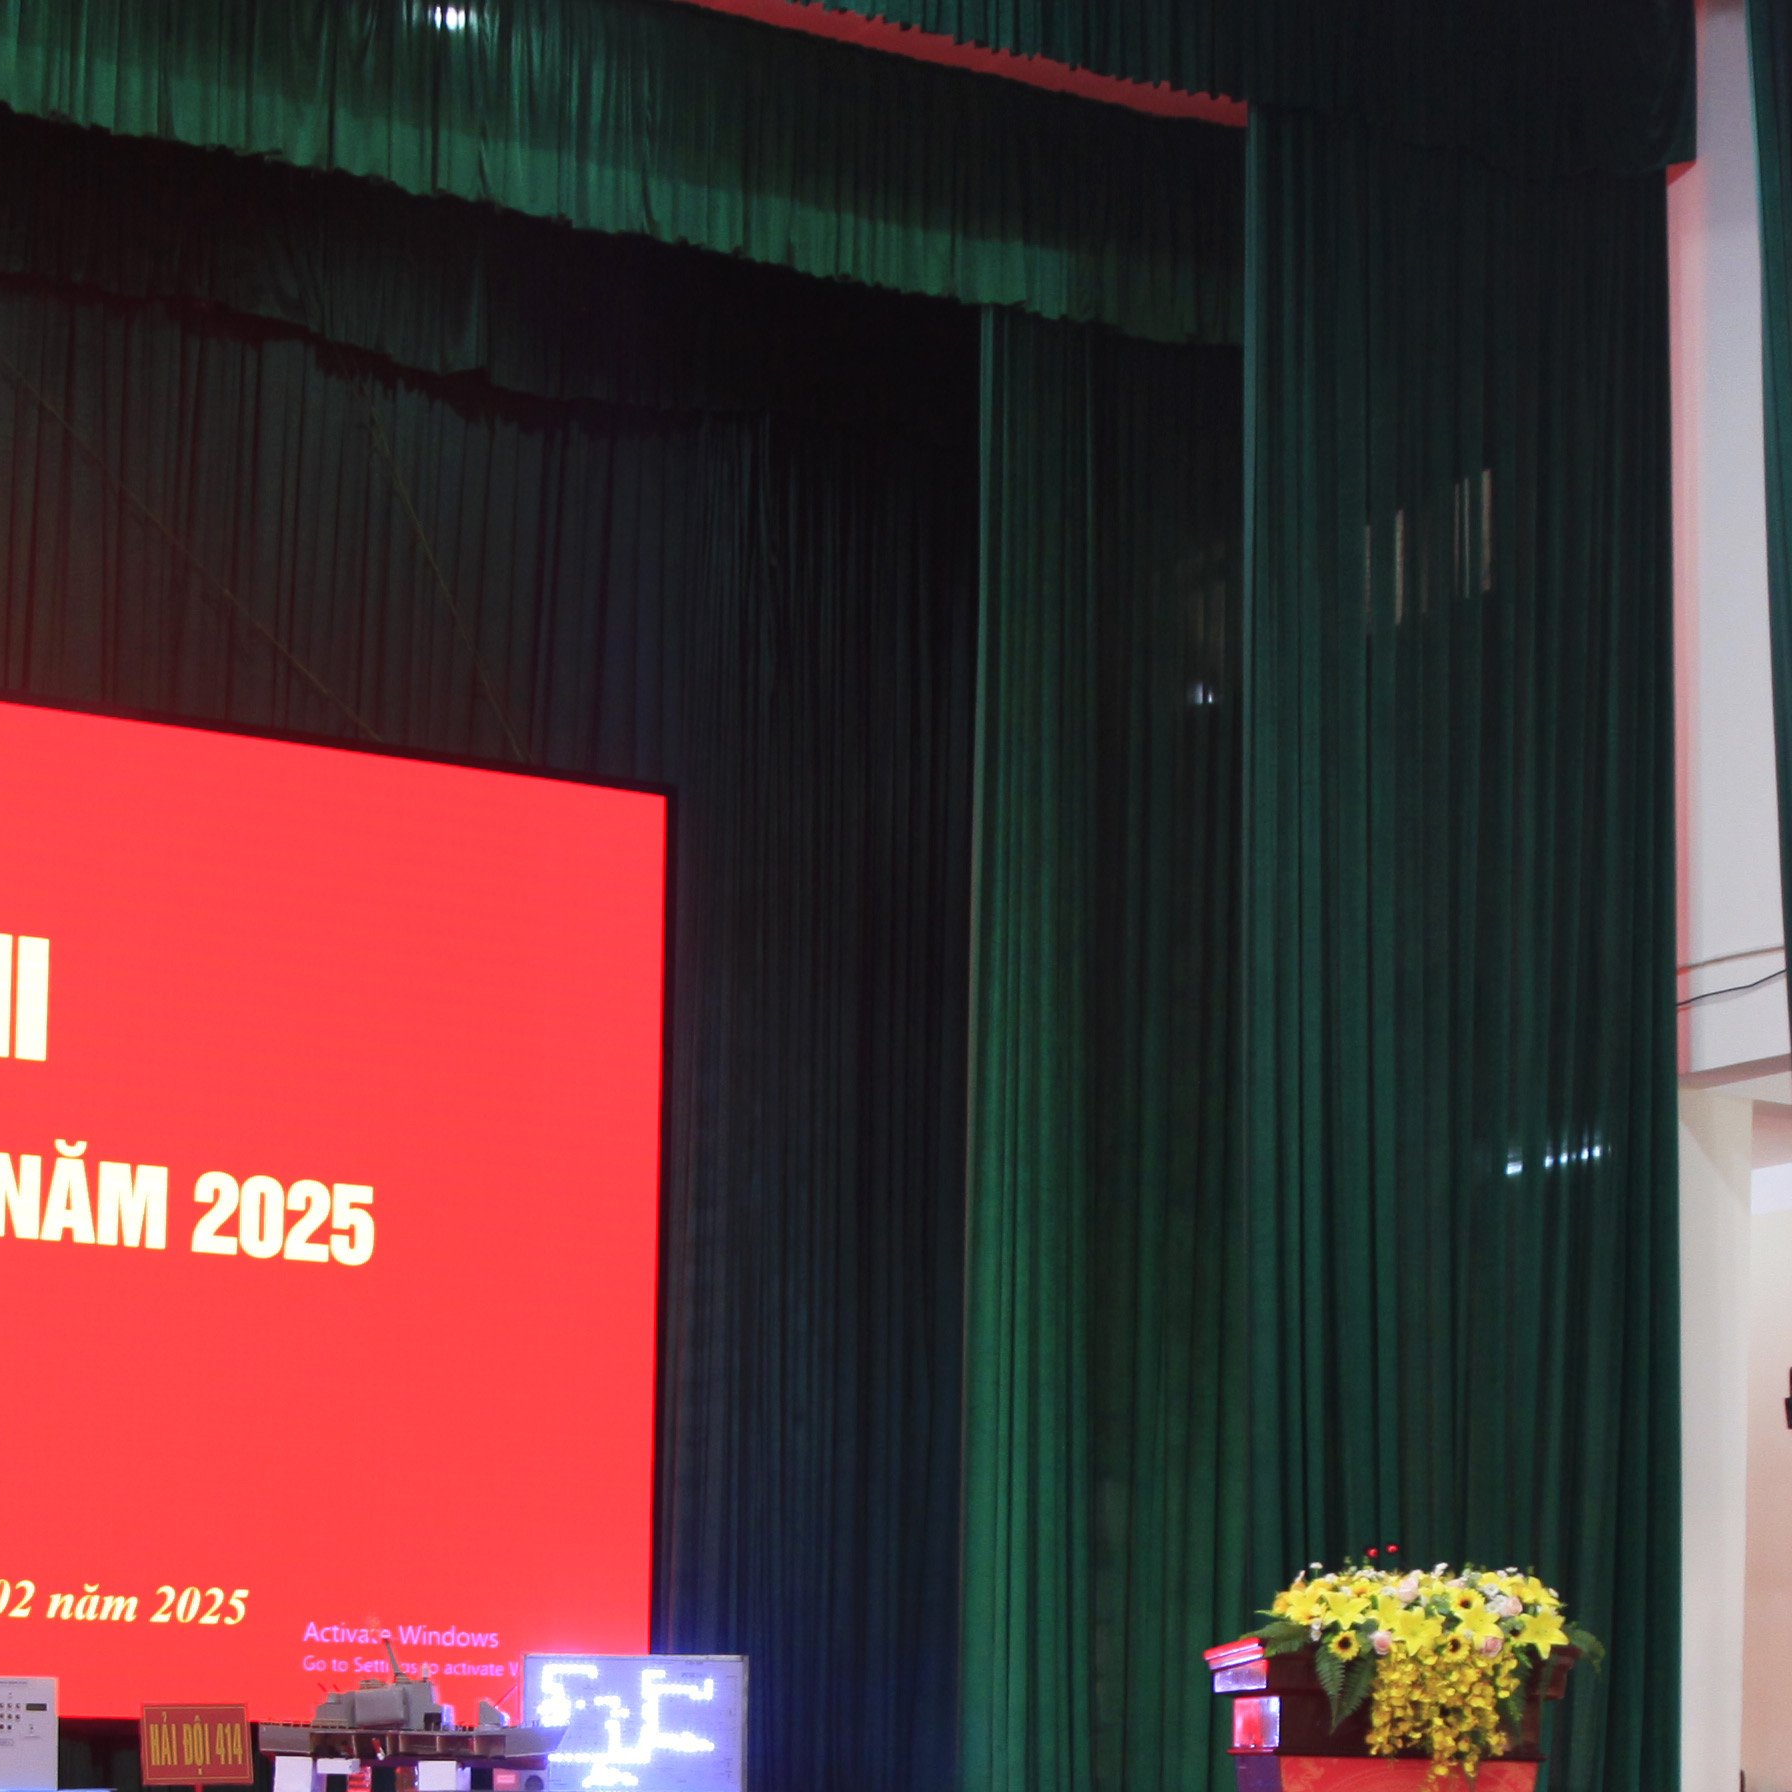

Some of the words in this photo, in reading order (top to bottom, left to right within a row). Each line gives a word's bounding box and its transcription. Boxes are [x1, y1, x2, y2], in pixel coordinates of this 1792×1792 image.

[191, 1170, 375, 1266] 2025
[46, 1583, 138, 1622] năm
[149, 1588, 250, 1627] 2025
[398, 1625, 499, 1648] Windows
[303, 1655, 326, 1672] Go
[332, 1658, 348, 1672] to
[354, 1656, 417, 1675] Settigs
[444, 1661, 504, 1676] activate
[150, 1711, 178, 1766] HẢI
[183, 1715, 211, 1775] ĐỘI
[216, 1723, 243, 1765] 414
